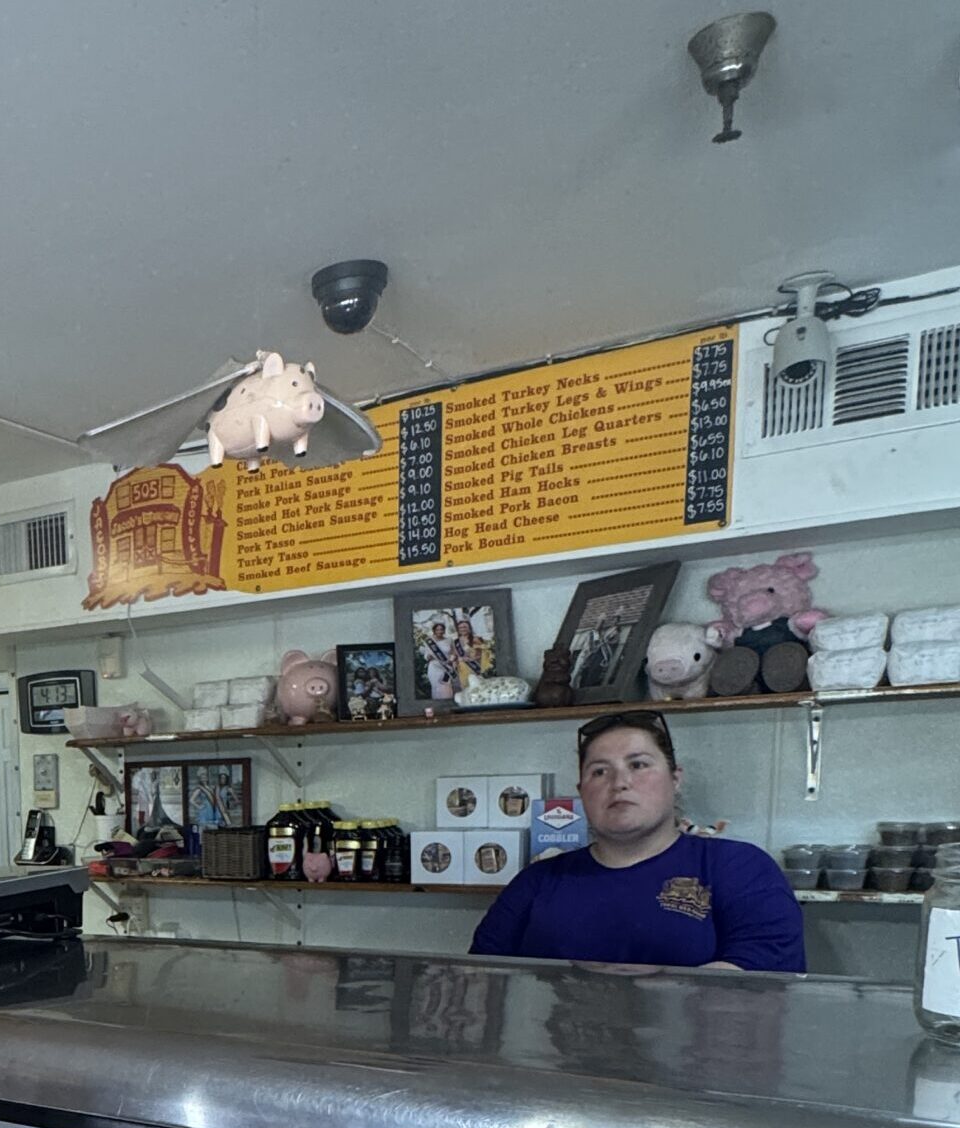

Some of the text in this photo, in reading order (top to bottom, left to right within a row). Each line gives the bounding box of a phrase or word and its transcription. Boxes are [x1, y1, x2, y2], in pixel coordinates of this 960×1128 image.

[445, 378, 662, 429] Smoked Turkey Legs & Wings
[446, 374, 599, 413] Smoked Turkey Necks
[445, 412, 661, 460] Smoked Chicken Leg Quarters
[133, 480, 158, 500] 505
[445, 494, 578, 523] Smoked Pork Bacon
[688, 500, 724, 518] $7.55
[237, 511, 377, 541] Smoked Chicken Sausage
[445, 513, 559, 538] Hog Head Cheese
[238, 557, 366, 581] Smoked Beef Sausage
